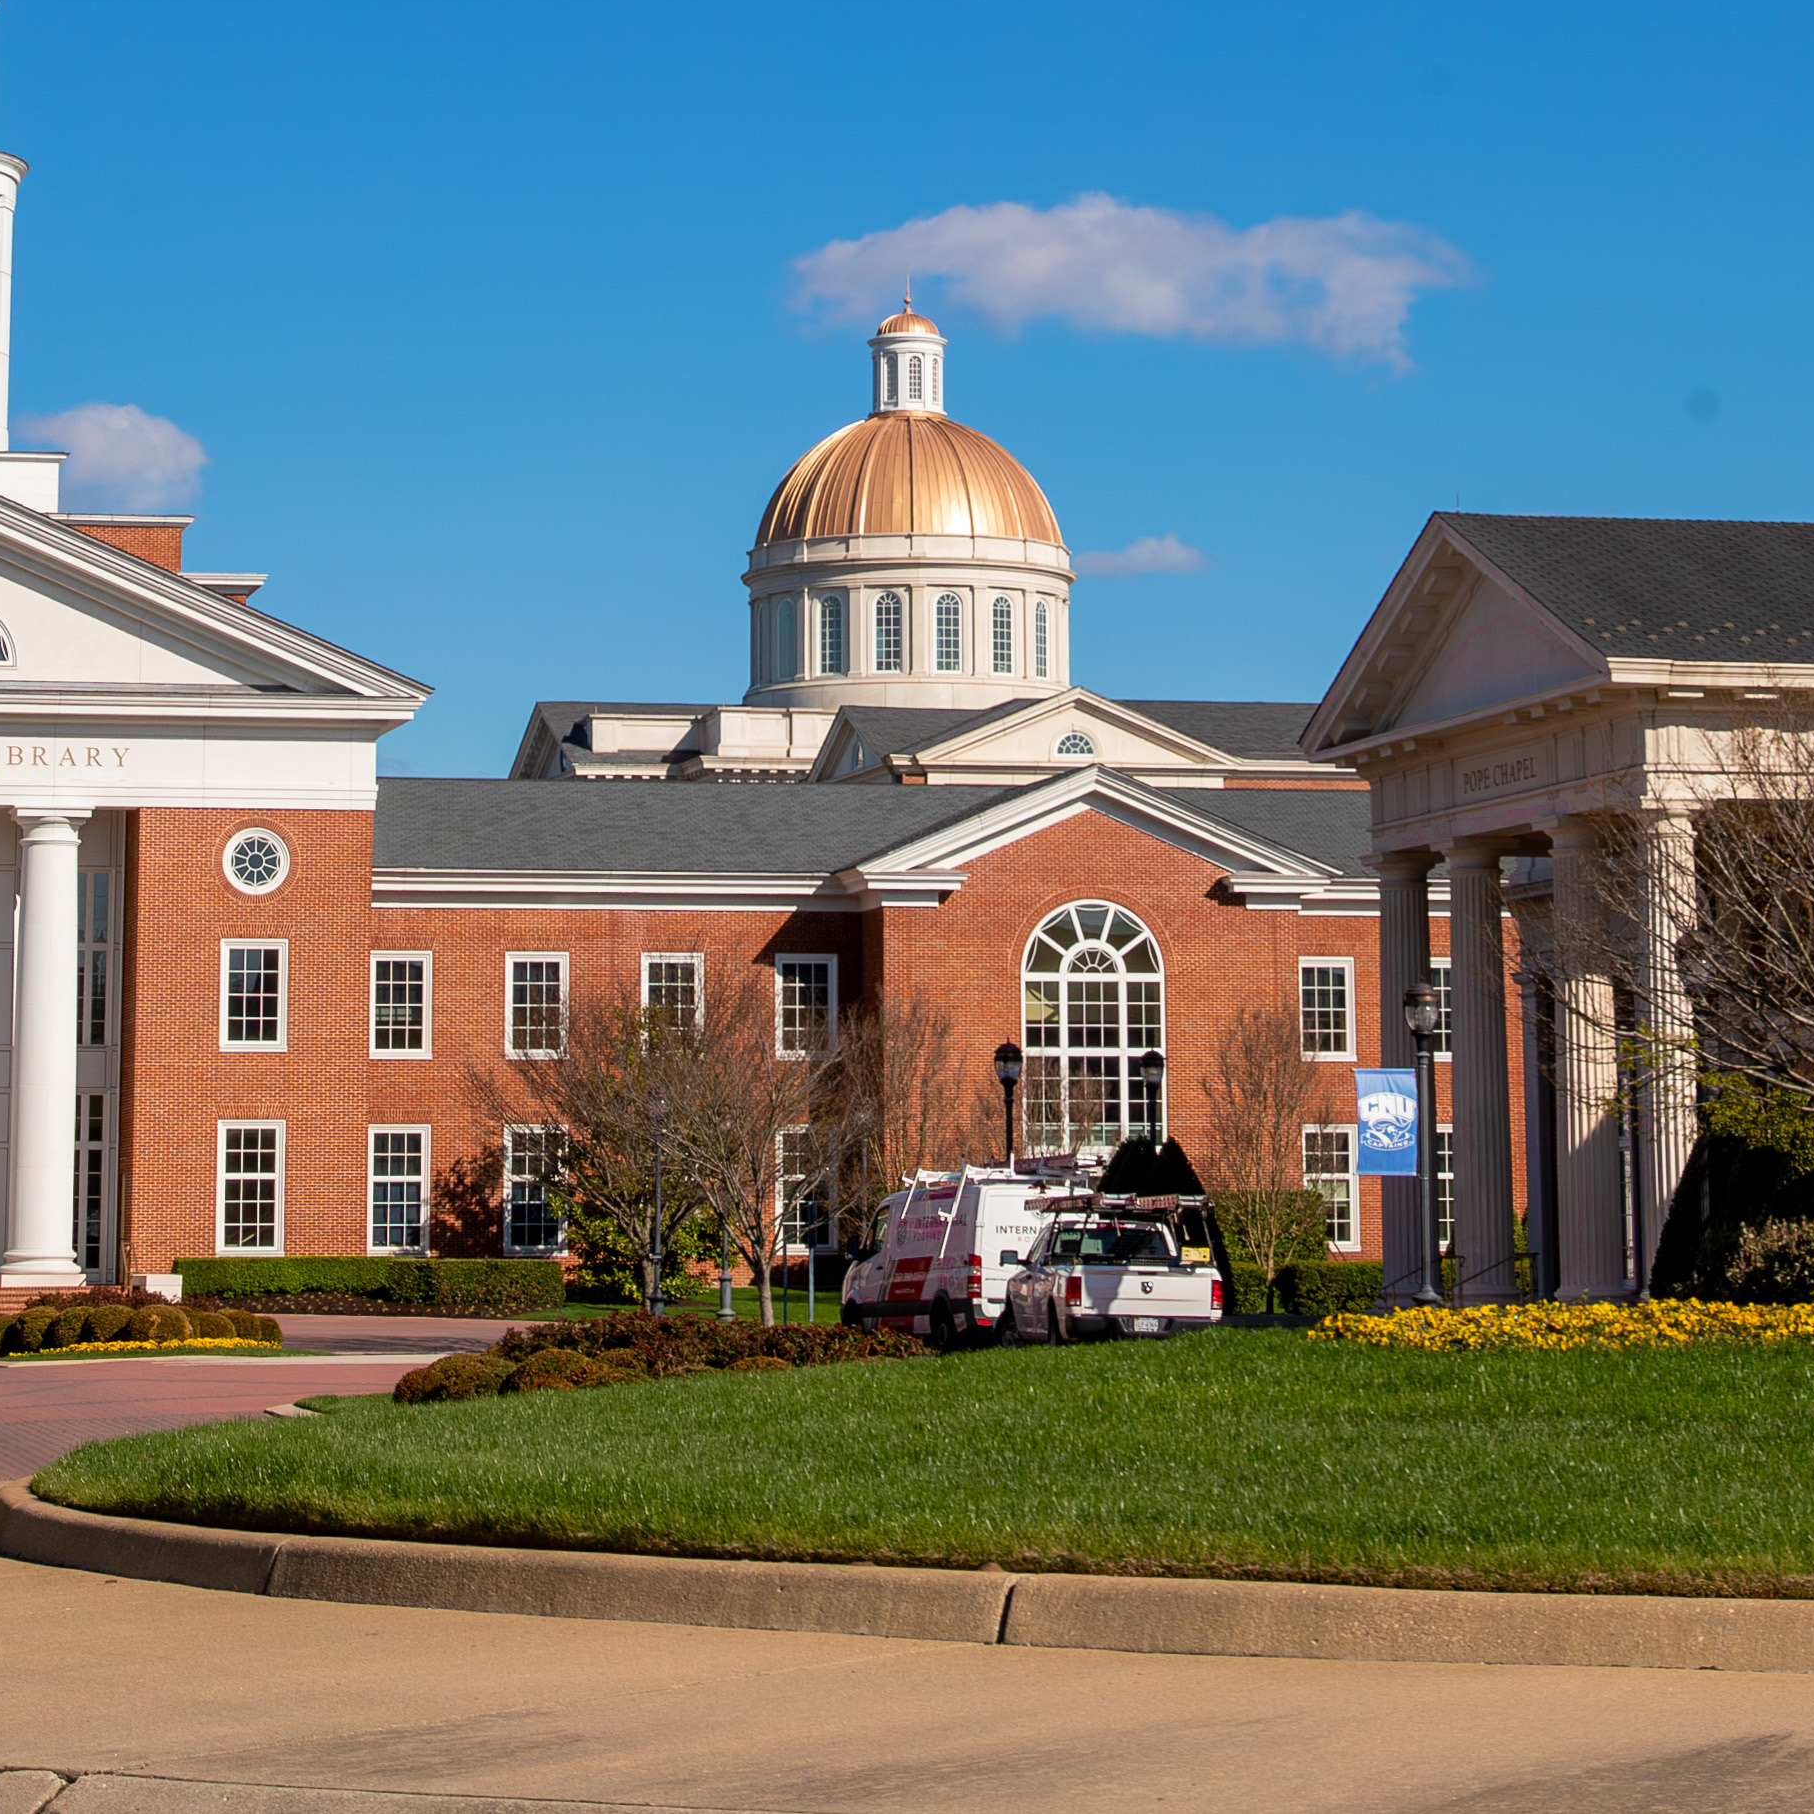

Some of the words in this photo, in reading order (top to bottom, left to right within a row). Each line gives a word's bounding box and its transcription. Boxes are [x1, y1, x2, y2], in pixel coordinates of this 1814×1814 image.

[1463, 768, 1490, 794] POPE
[1493, 757, 1537, 787] CHAPEL
[1360, 1093, 1415, 1121] CNU
[1367, 1138, 1408, 1148] CAPTAINS
